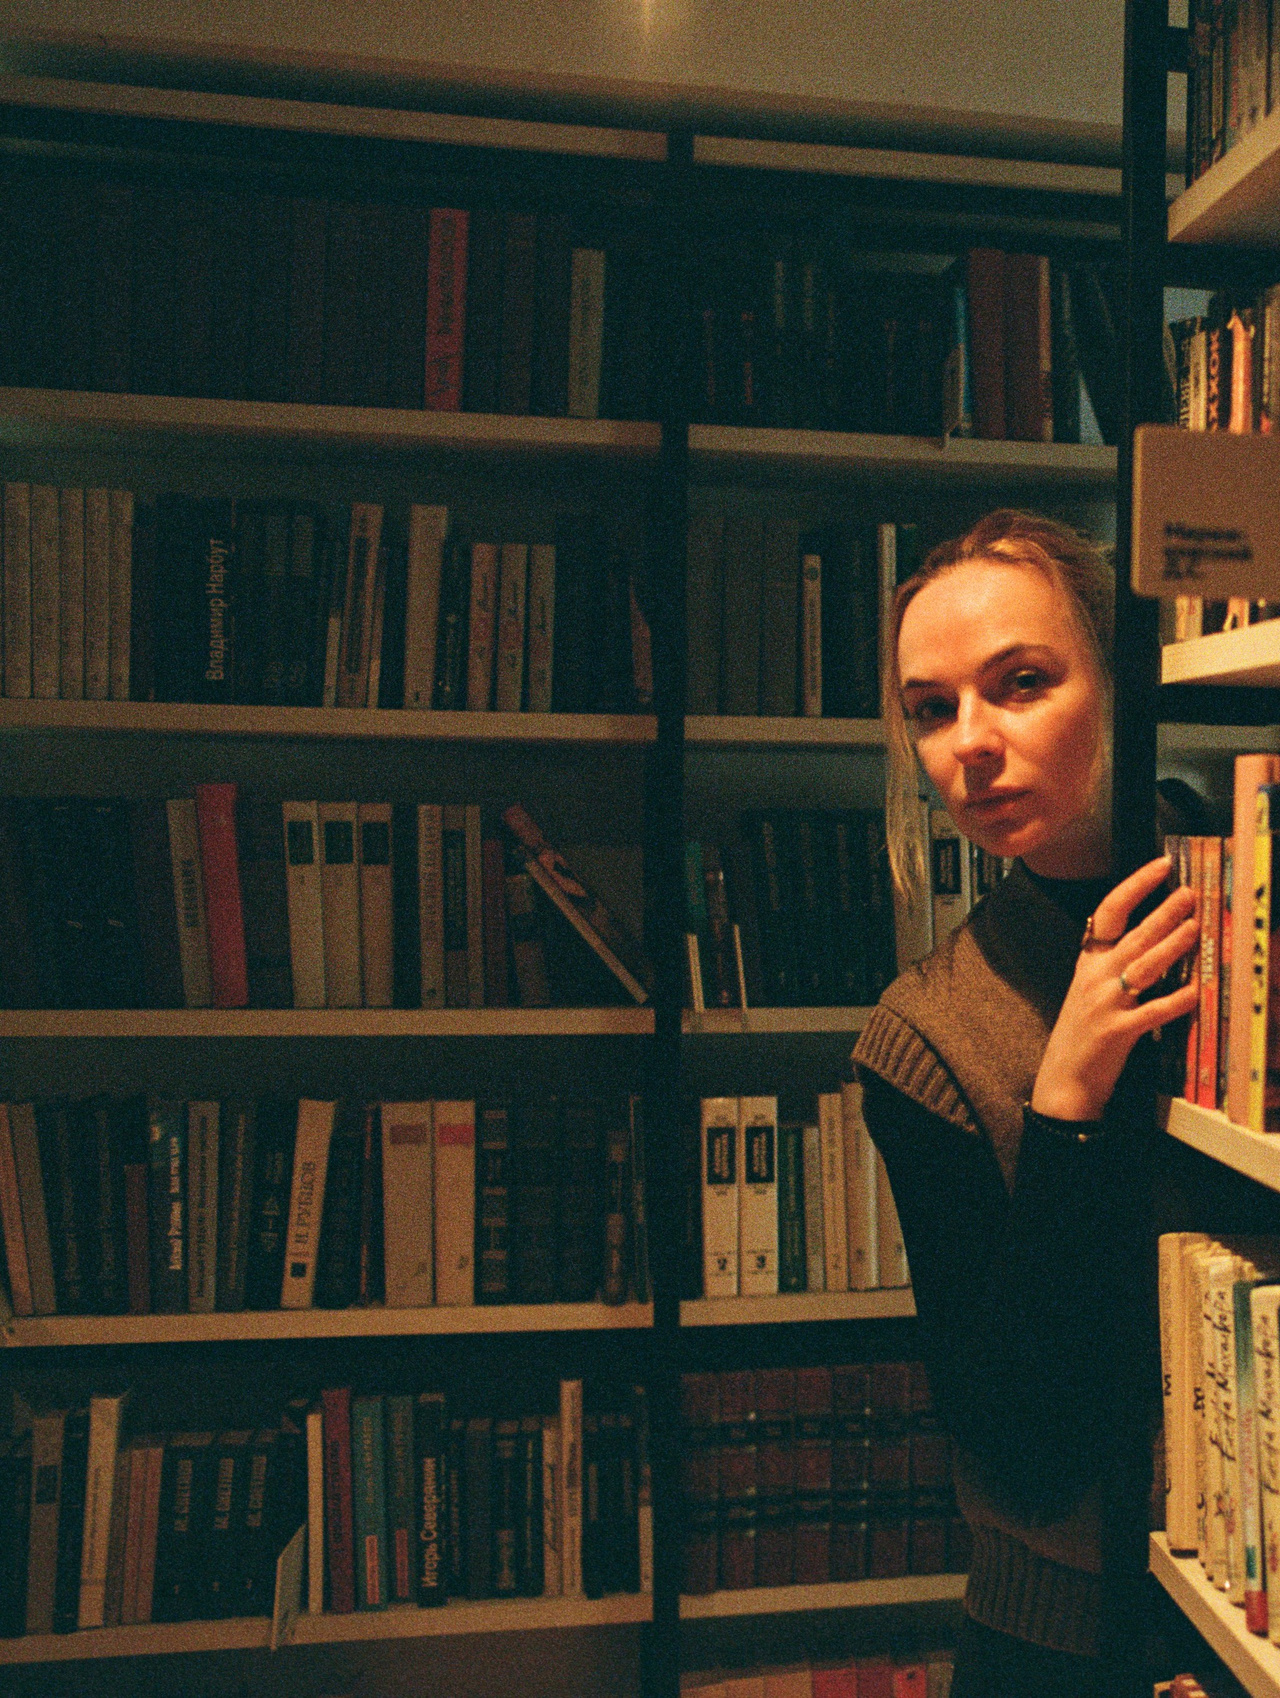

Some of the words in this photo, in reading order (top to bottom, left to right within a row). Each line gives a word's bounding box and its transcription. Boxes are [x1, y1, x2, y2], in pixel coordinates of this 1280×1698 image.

[205, 538, 229, 595] Нарбут
[205, 598, 229, 681] Владимир
[420, 1457, 439, 1541] Северянин
[421, 1542, 439, 1587] Игорь
